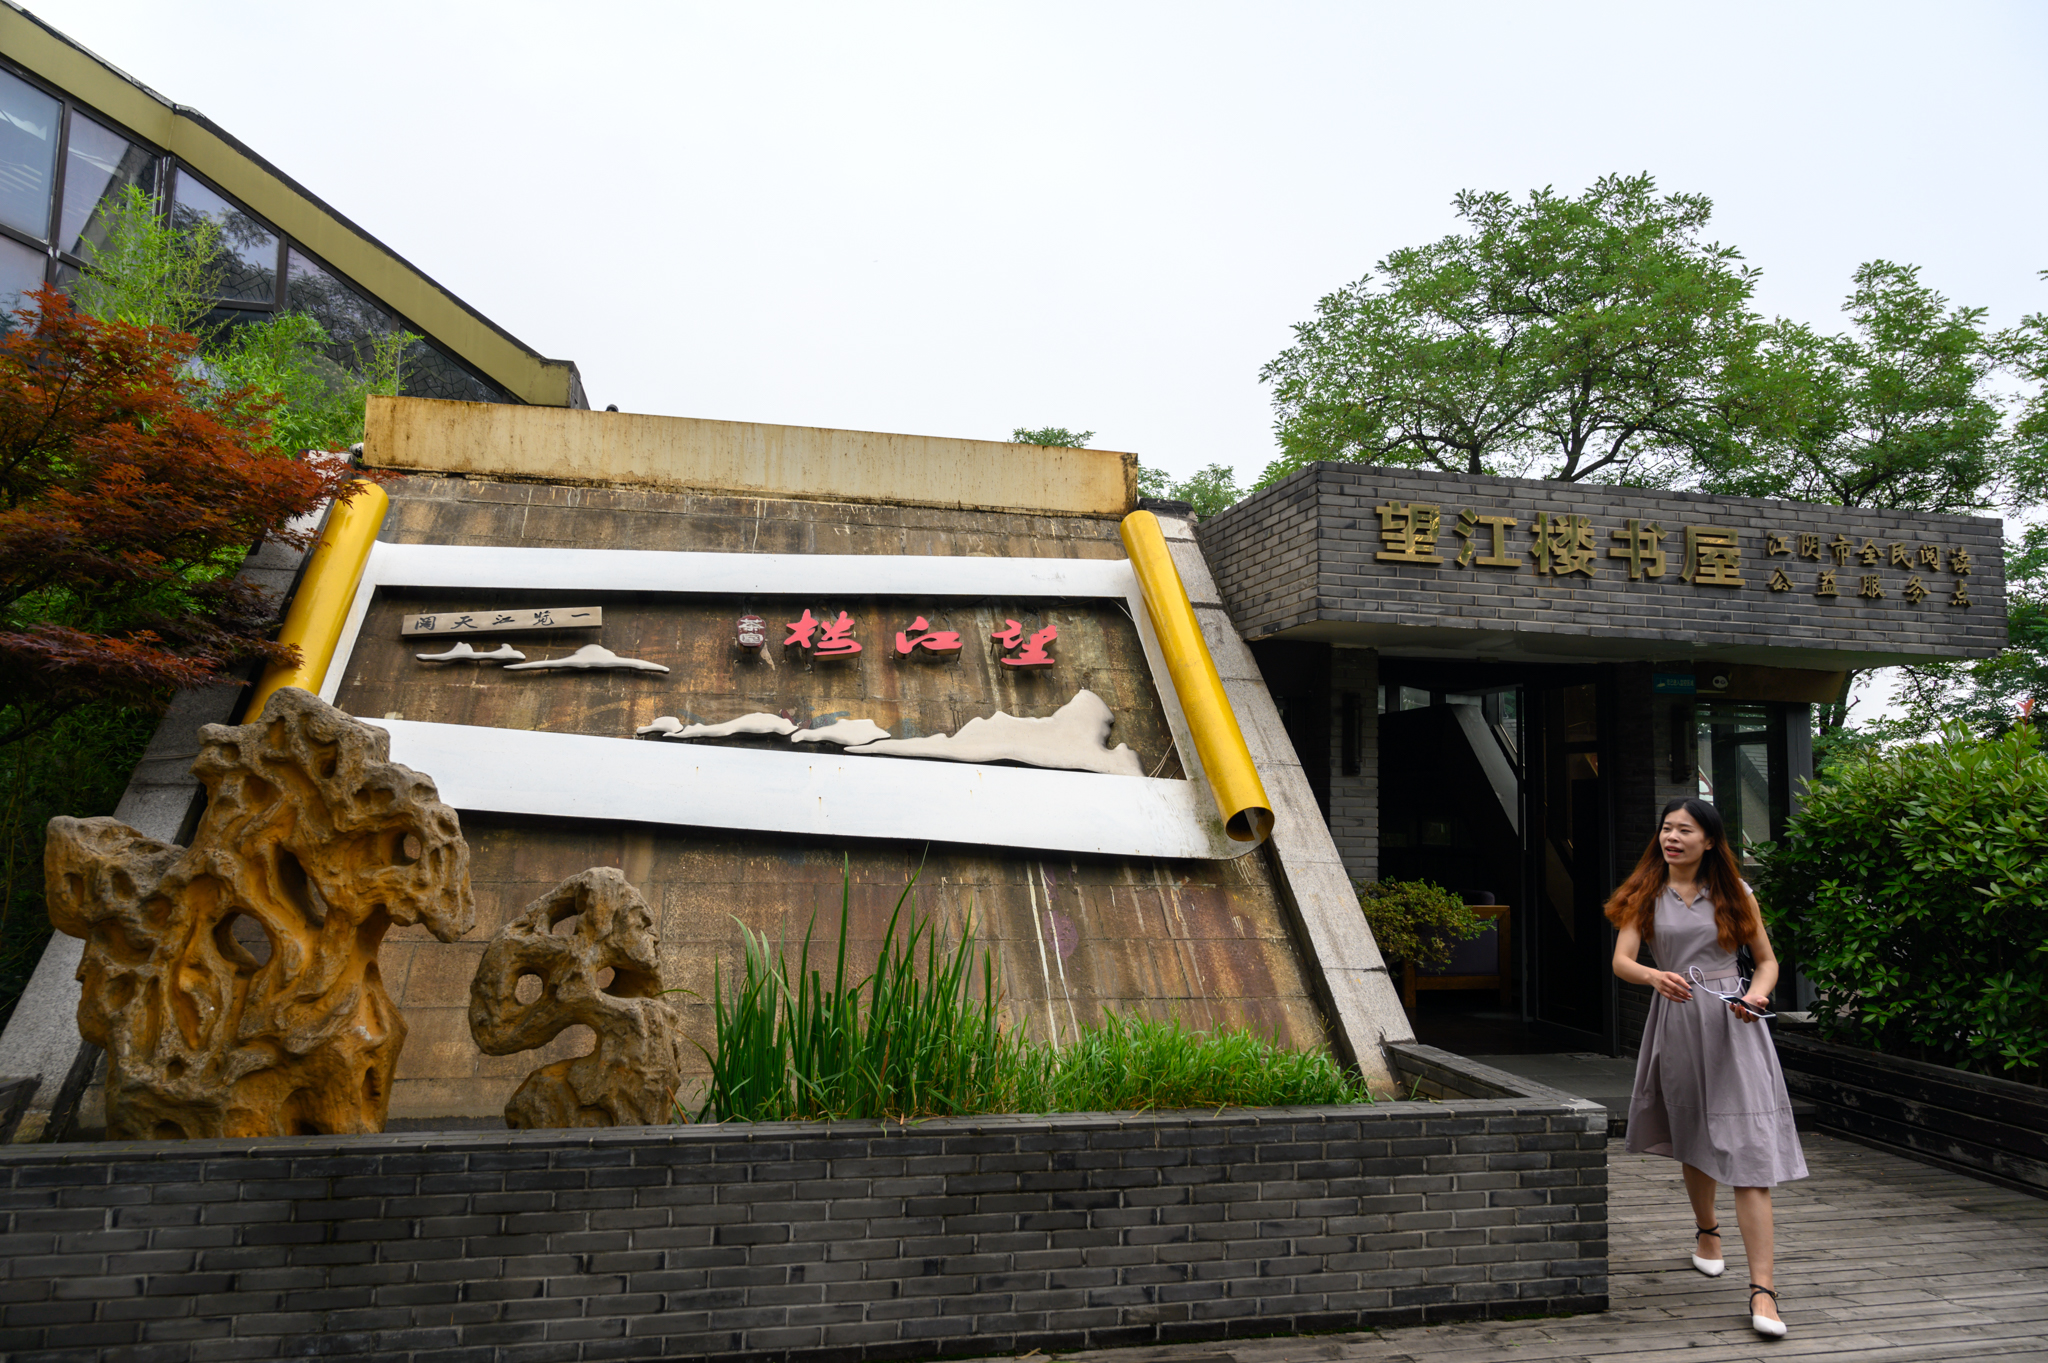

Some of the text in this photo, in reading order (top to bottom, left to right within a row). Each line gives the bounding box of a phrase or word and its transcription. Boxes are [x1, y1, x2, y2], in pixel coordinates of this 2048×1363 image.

[1375, 501, 1746, 587] 望江楼书屋
[1766, 531, 1972, 575] 江阴市全民阅读
[1766, 566, 1973, 607] 公益服务点
